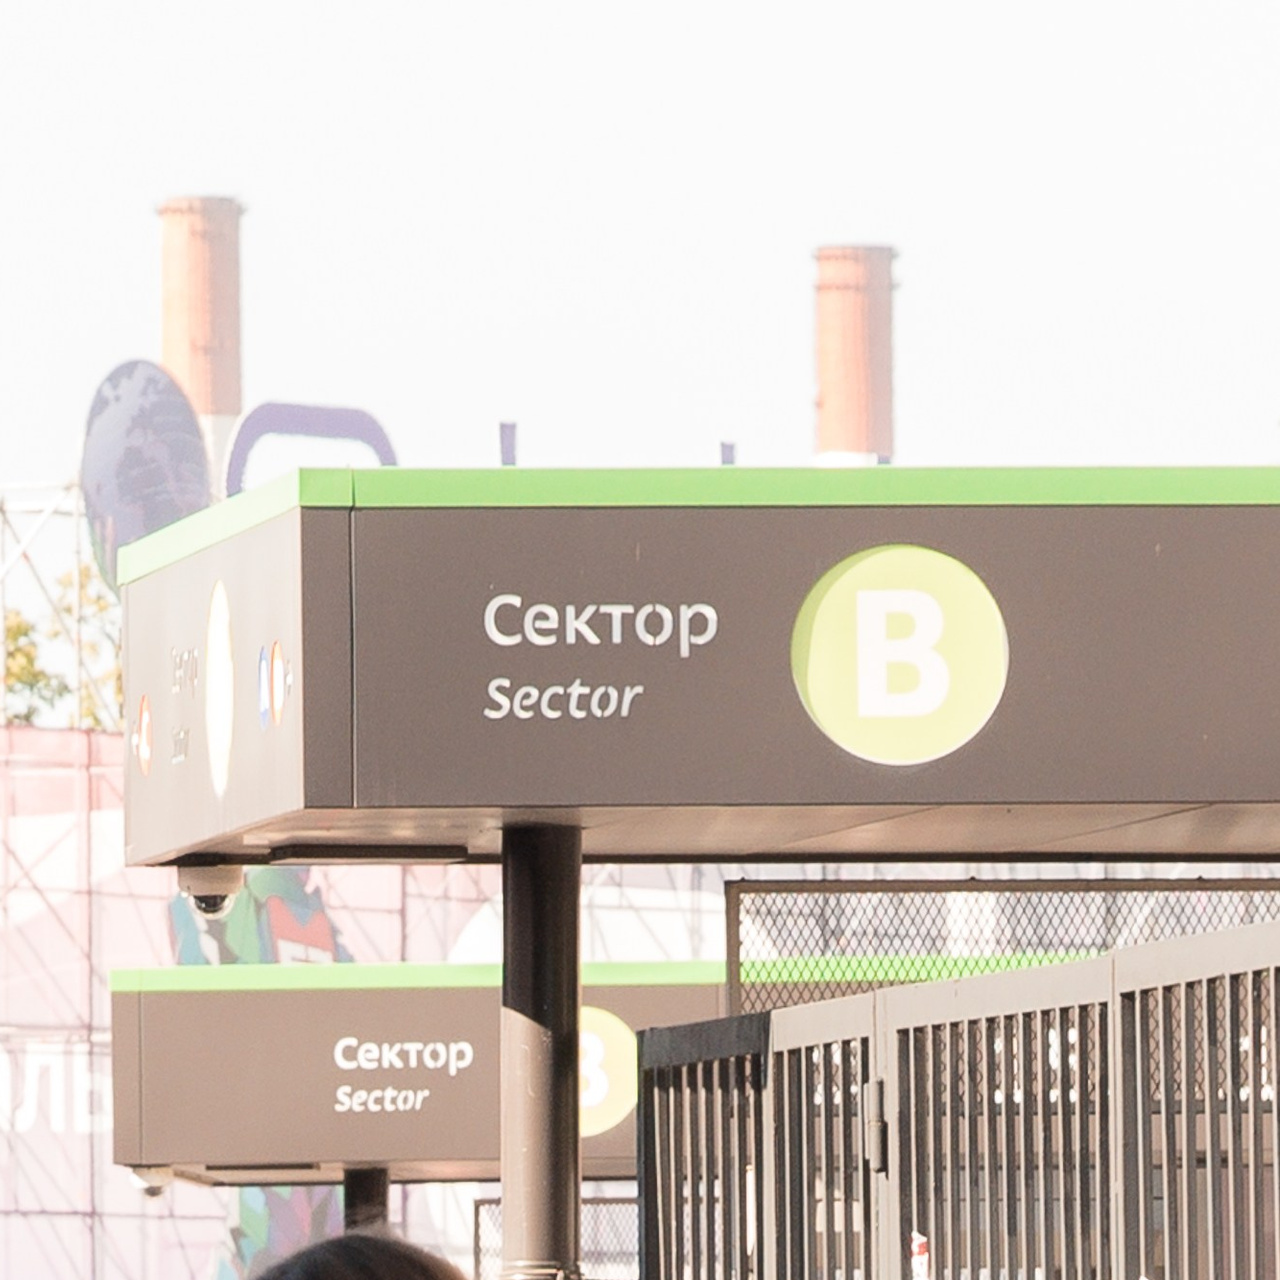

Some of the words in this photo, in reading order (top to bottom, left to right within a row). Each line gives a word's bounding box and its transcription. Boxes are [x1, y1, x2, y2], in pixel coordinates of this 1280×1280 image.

[483, 594, 718, 658] Сектор
[856, 589, 953, 717] B
[483, 677, 645, 719] Sector
[334, 1037, 474, 1076] Сектор
[334, 1085, 430, 1112] Sector
